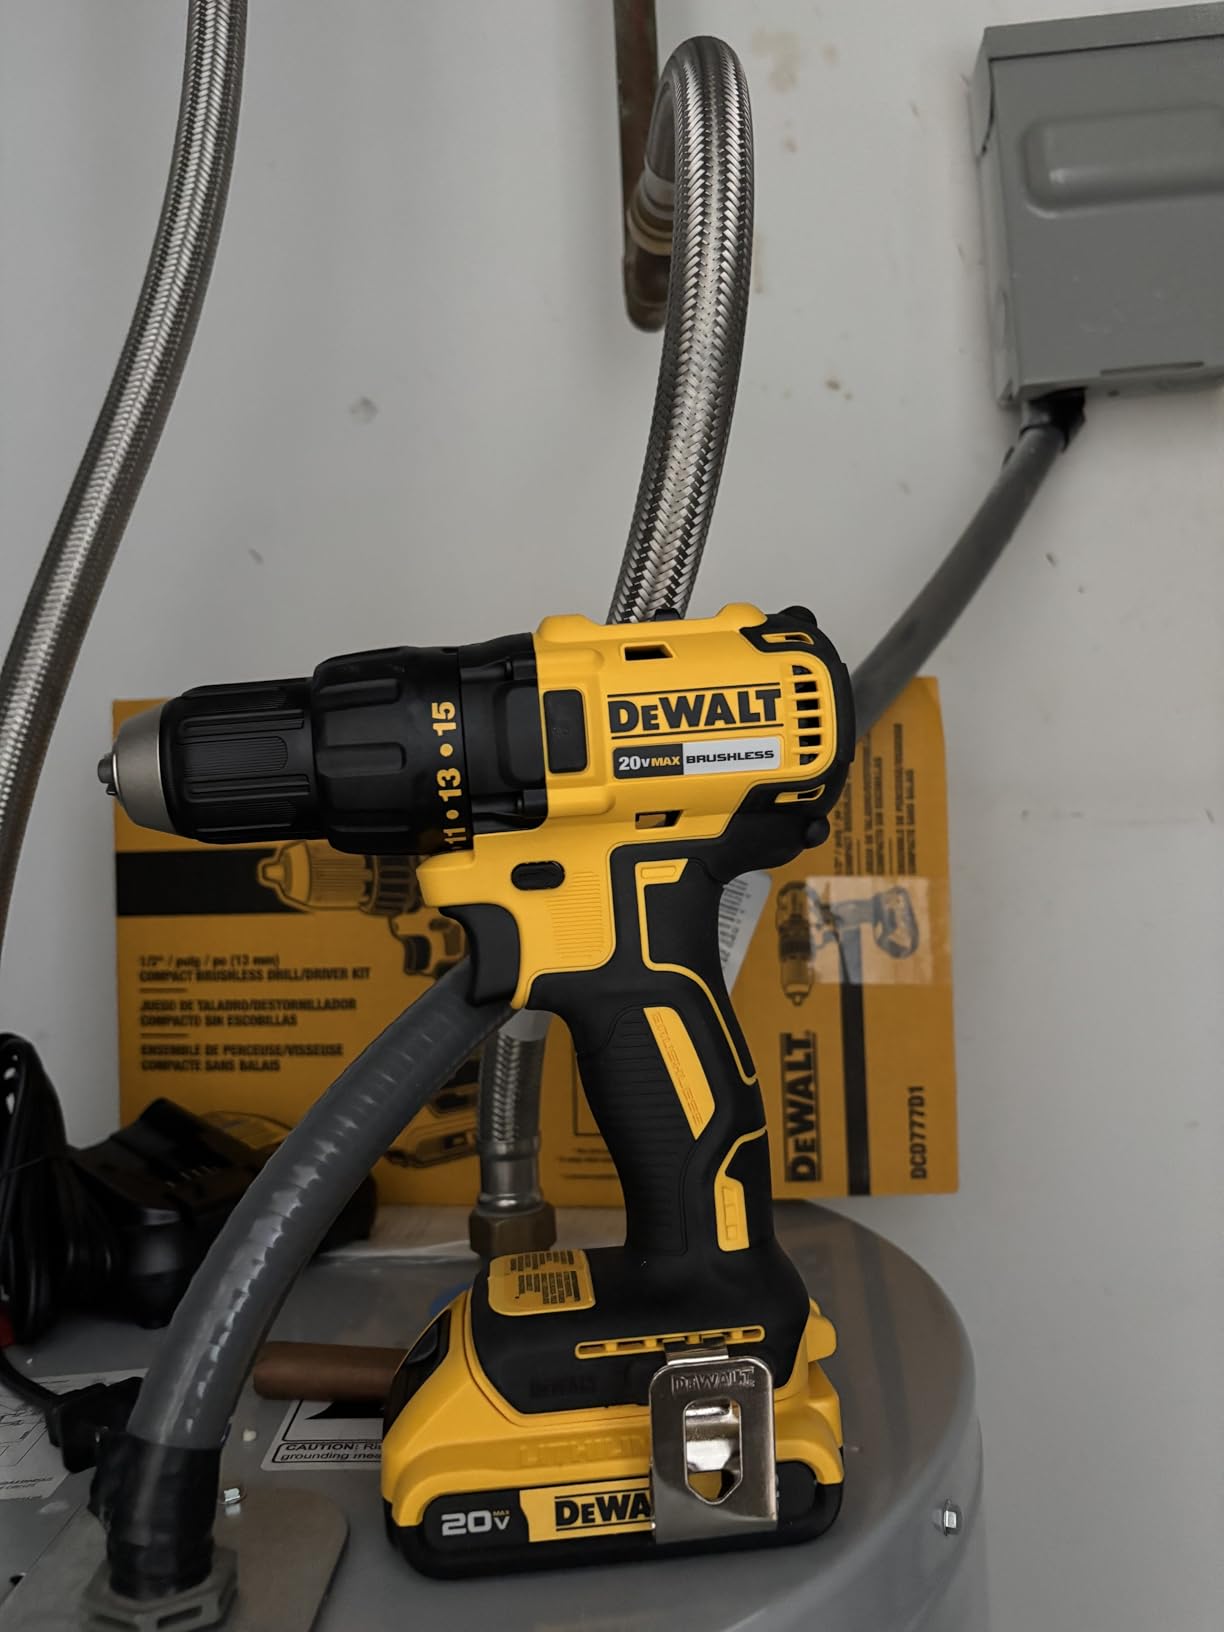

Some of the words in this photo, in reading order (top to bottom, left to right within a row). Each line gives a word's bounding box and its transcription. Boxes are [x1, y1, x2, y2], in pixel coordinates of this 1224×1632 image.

[431, 701, 457, 737] 15
[607, 688, 782, 733] DEWALT
[686, 750, 774, 764] BRUSHLESS
[436, 767, 462, 802] 13
[442, 827, 467, 845] 11
[139, 968, 193, 982] COMPACT
[196, 968, 264, 982] BRUSHLESS
[267, 967, 348, 981] DRILL/DRIVER
[351, 966, 371, 980] KIT
[179, 998, 193, 1012] DE
[783, 1032, 817, 1182] DEWALT
[905, 1085, 928, 1181] DCD777D1
[280, 1451, 350, 1461] grounding
